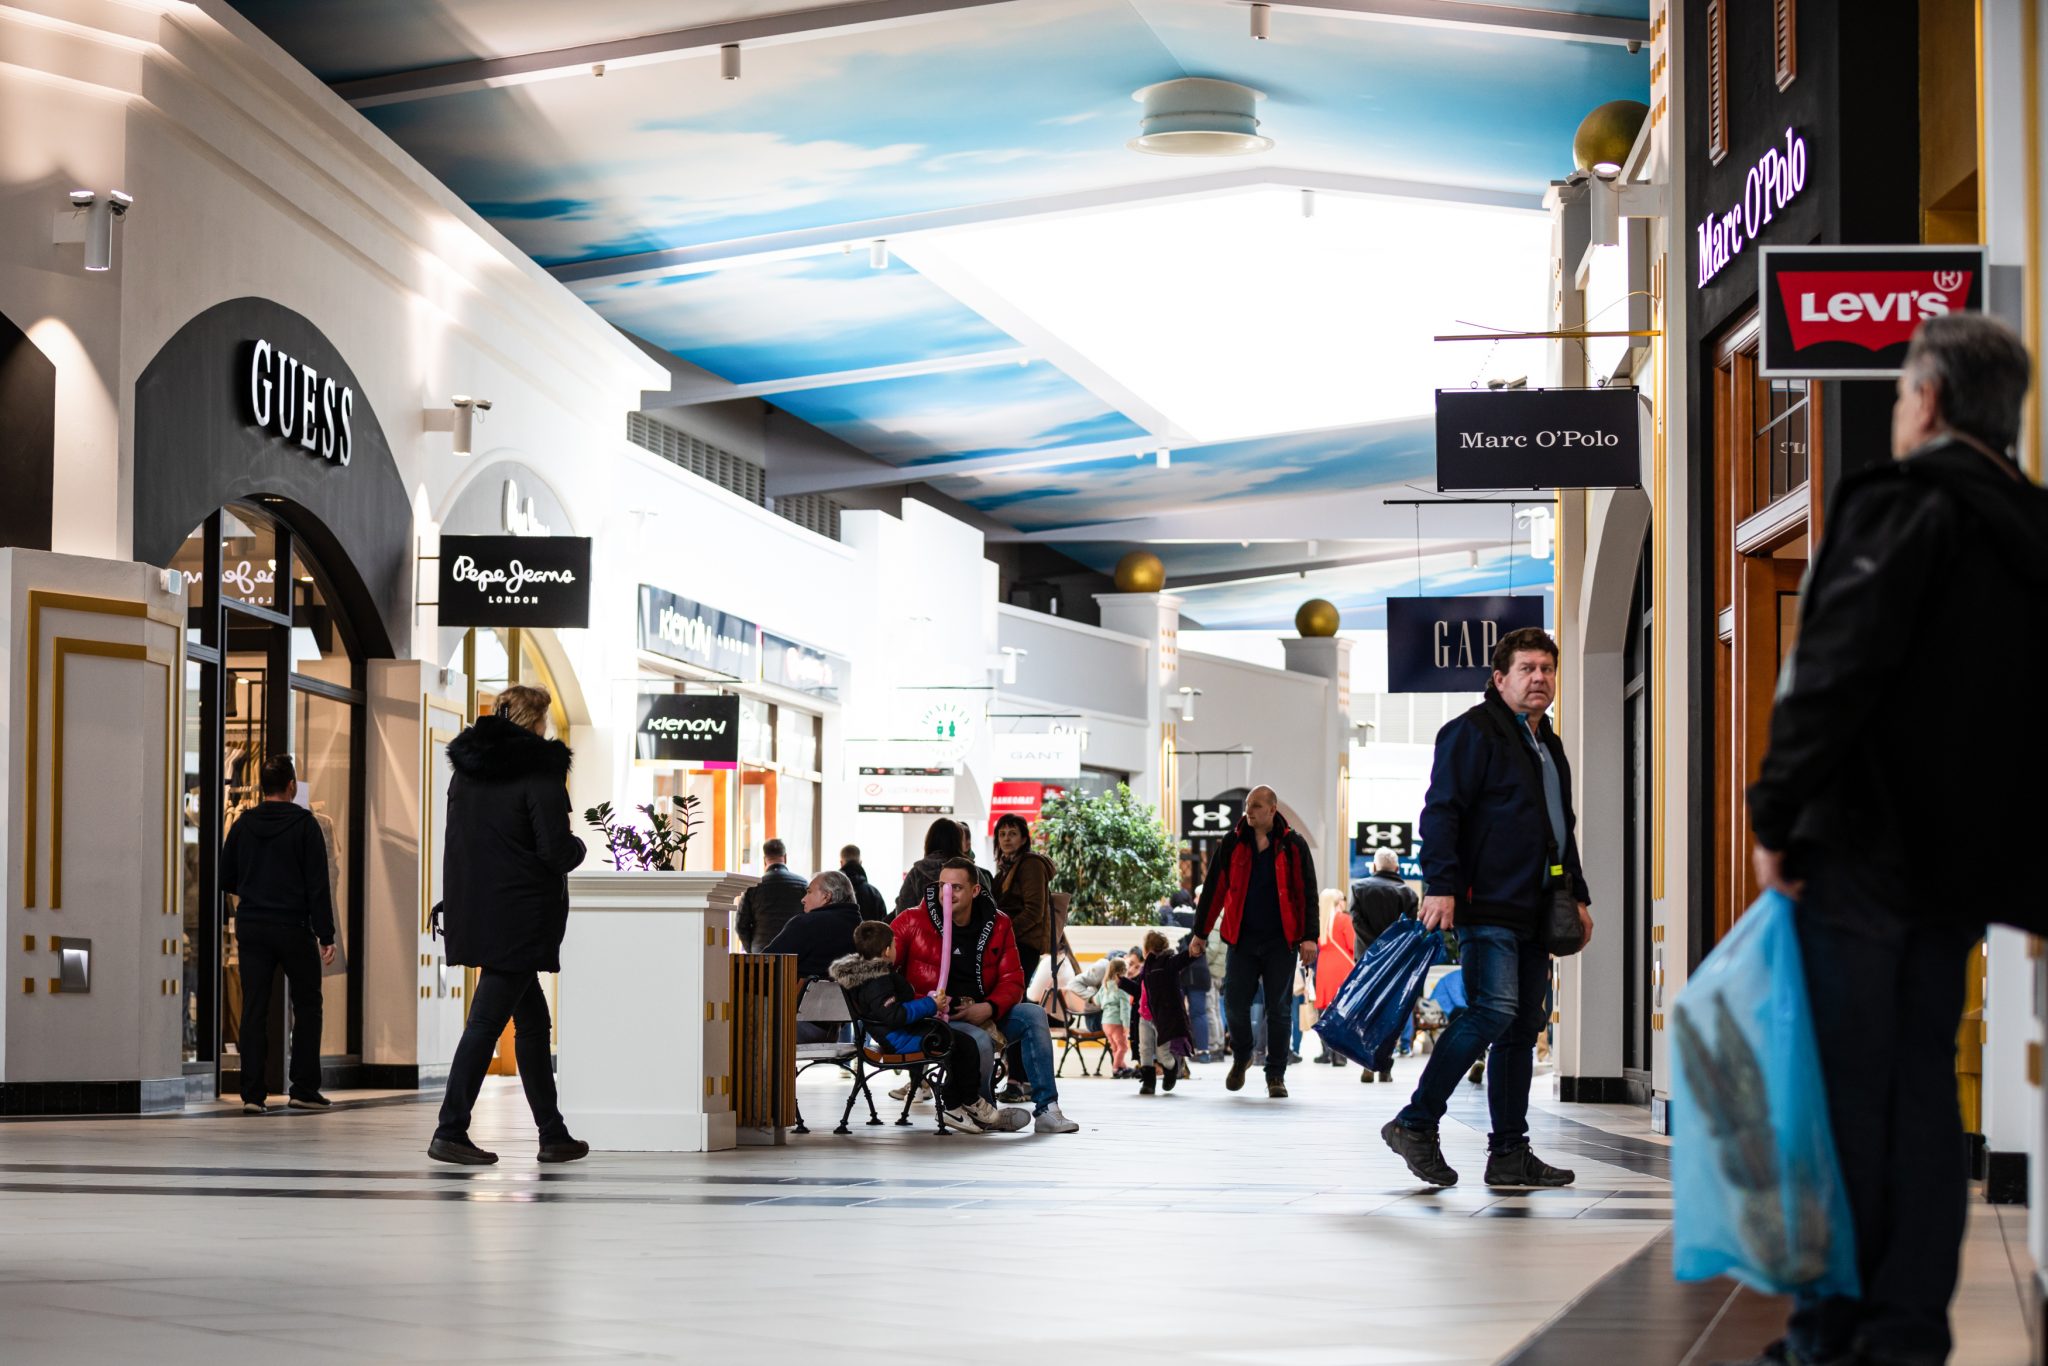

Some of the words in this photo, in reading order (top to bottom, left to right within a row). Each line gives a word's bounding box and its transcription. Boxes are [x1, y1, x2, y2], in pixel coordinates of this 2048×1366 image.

[1698, 204, 1742, 289] Marc
[1745, 126, 1806, 239] O'Polo
[252, 338, 353, 467] GUESS
[1459, 432, 1528, 449] Marc
[1535, 430, 1619, 448] O'Polo
[453, 555, 507, 592] Pepe
[505, 560, 576, 593] Jeans
[488, 596, 538, 604] LONDON
[1434, 620, 1498, 669] GAP
[661, 733, 713, 741] AURUM
[1010, 751, 1064, 760] GANT
[976, 920, 994, 951] GUESS
